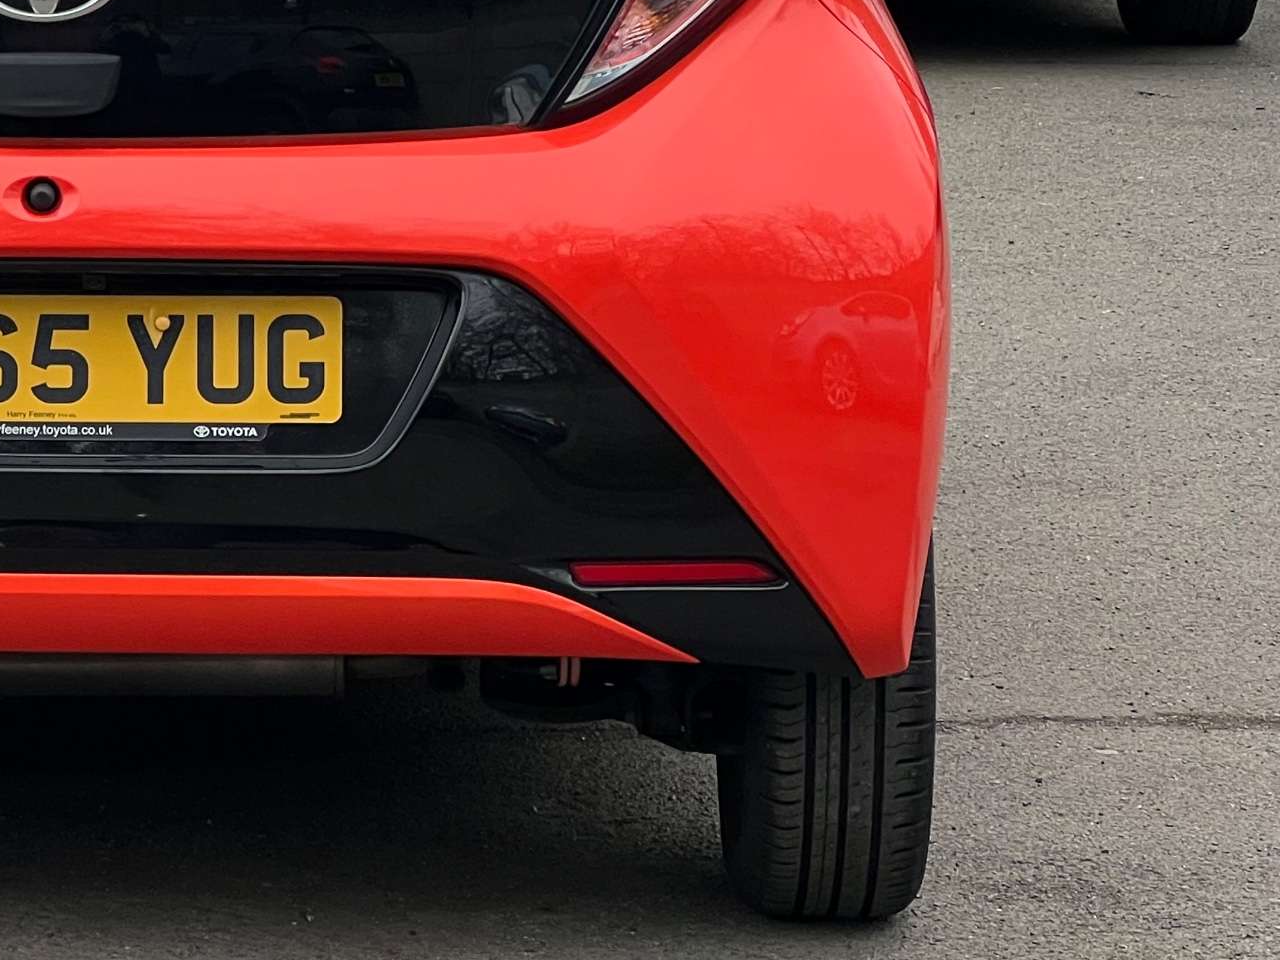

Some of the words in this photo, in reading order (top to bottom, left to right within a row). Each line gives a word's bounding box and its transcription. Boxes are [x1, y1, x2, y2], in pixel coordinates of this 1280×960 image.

[126, 313, 326, 405] YUG
[6, 410, 27, 419] Harry
[28, 410, 56, 419] Feeney
[211, 426, 258, 437] TOYOTA
